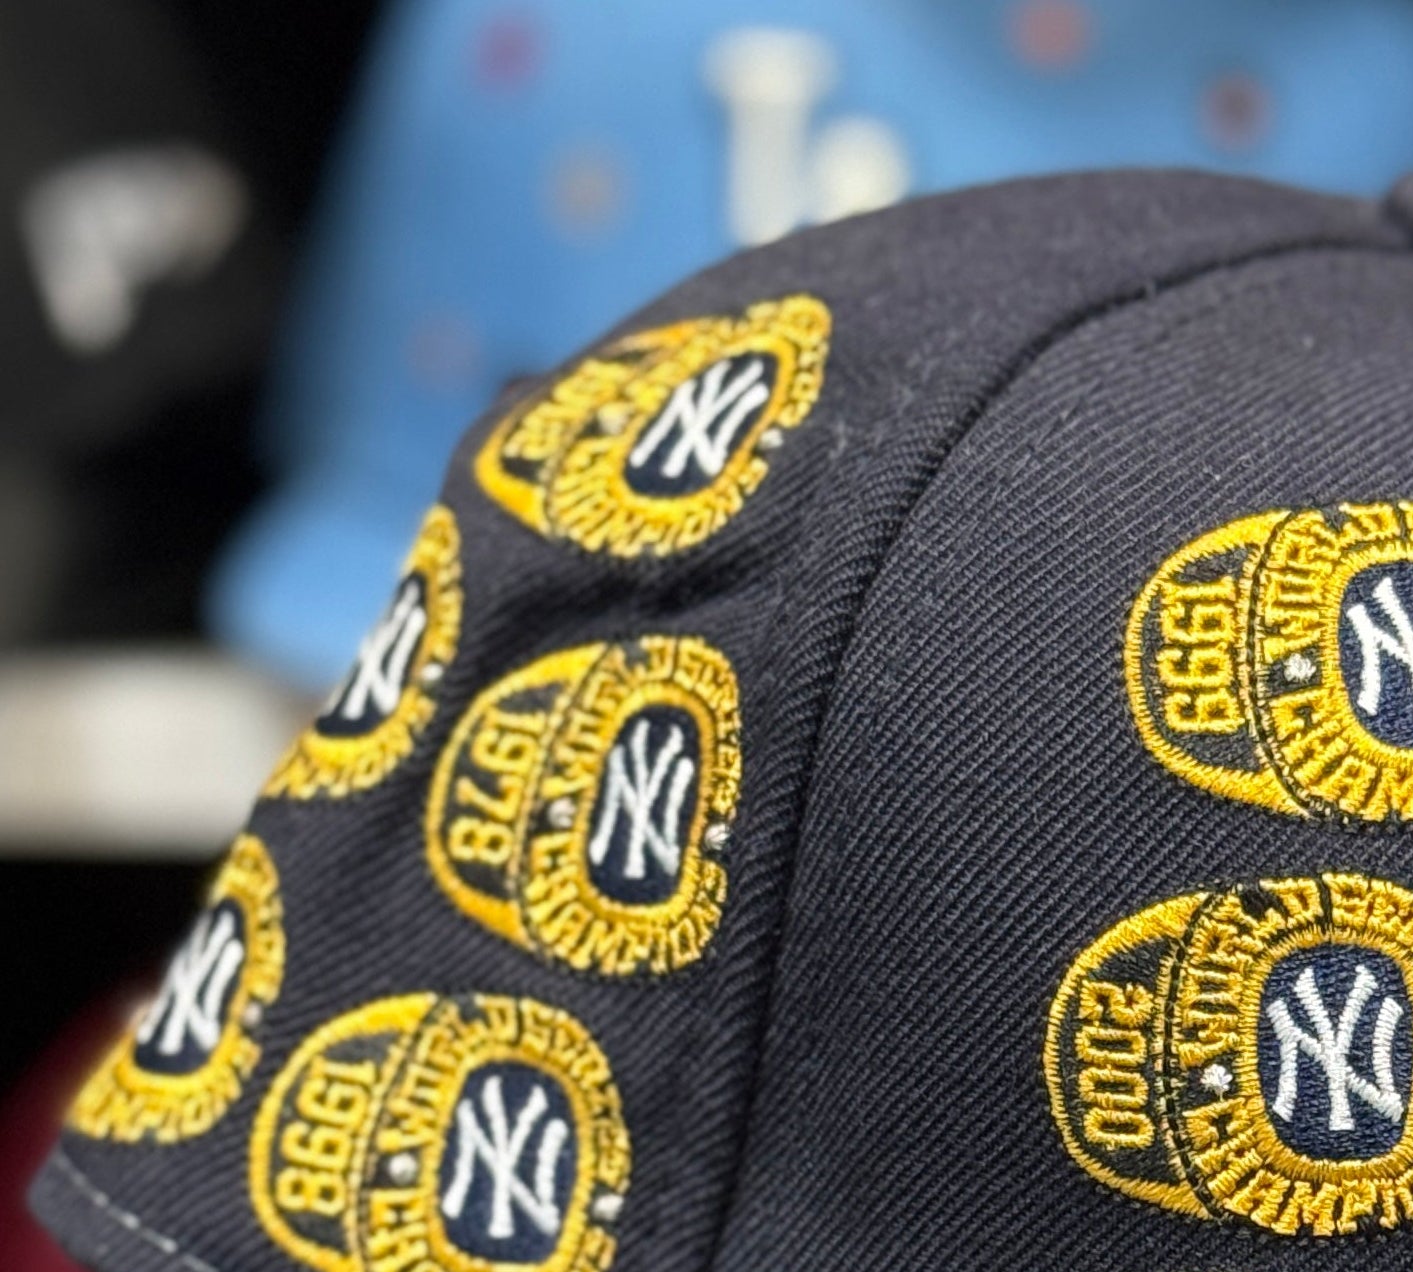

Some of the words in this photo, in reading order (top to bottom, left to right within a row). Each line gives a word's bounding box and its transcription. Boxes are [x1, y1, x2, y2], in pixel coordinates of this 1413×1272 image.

[630, 358, 770, 478] NY
[1157, 574, 1245, 734] 1999
[448, 705, 547, 866] 1978
[588, 718, 695, 880] NY
[524, 832, 729, 976] CHAMPIONS
[1074, 979, 1156, 1150] 2000
[1267, 963, 1404, 1132] NY
[275, 1055, 377, 1217] 1998
[441, 1075, 569, 1239] NY
